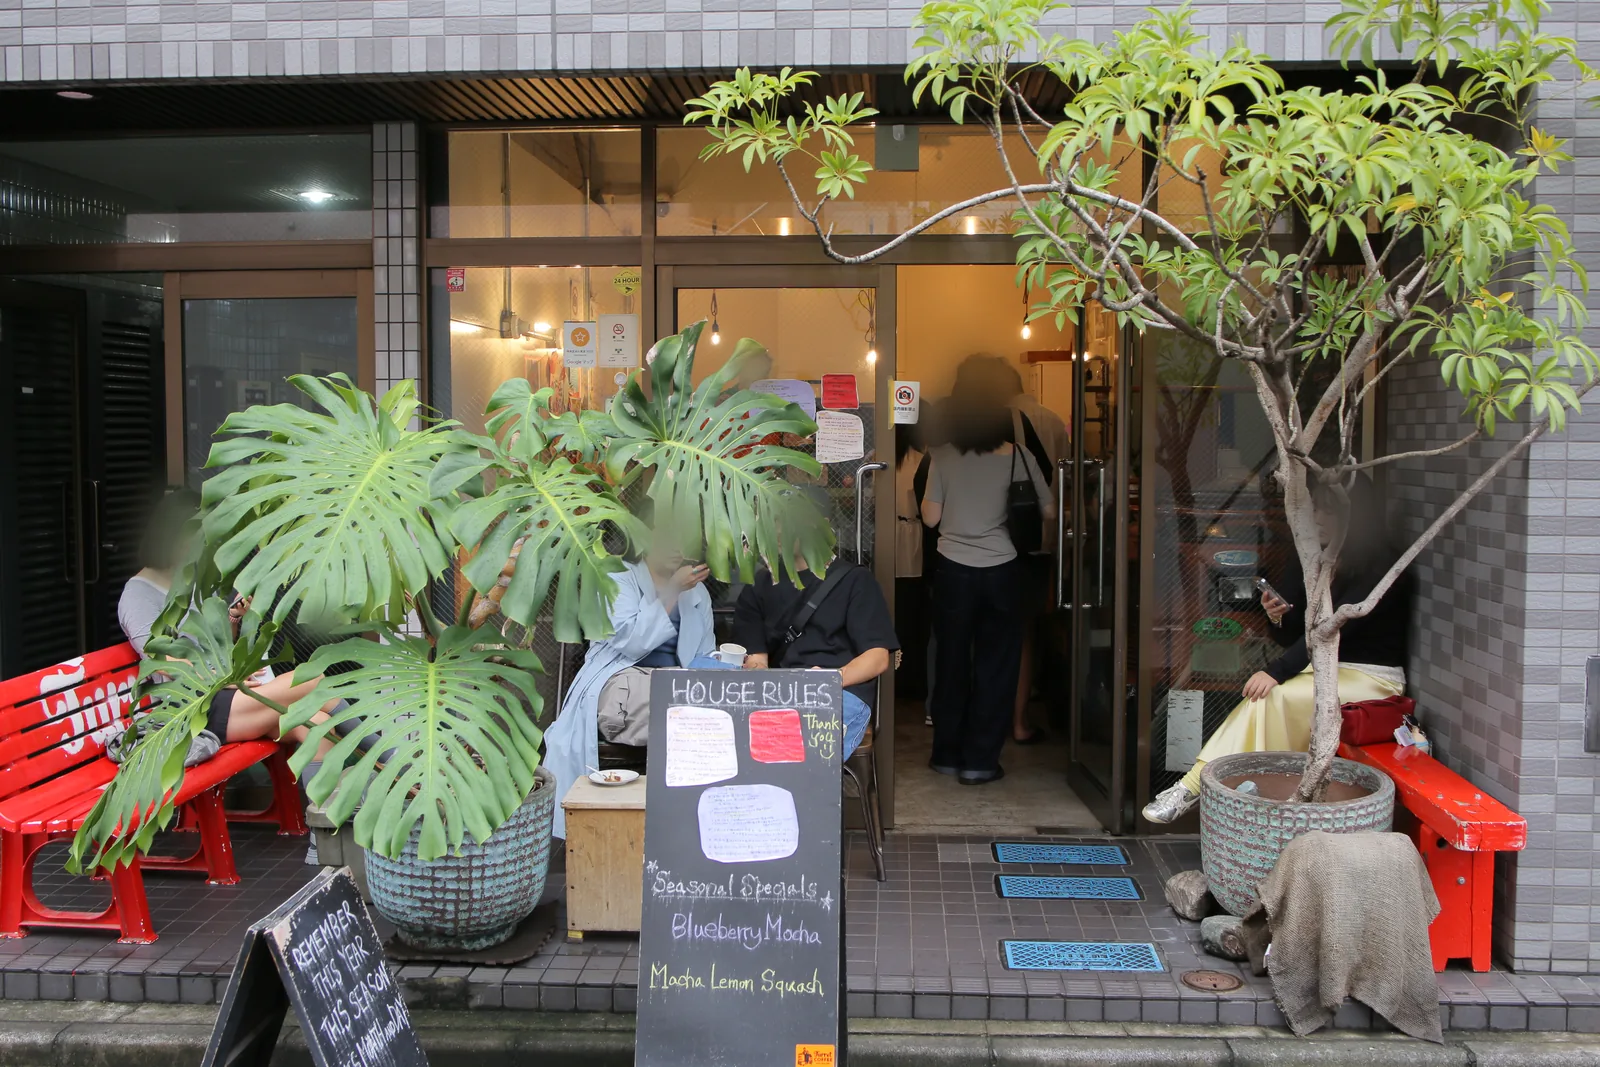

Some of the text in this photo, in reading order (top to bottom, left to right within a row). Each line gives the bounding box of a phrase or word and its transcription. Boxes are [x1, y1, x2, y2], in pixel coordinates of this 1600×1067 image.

[672, 678, 833, 707] HOUSE RULES
[802, 712, 840, 731] Thank
[809, 732, 836, 748] you
[652, 870, 818, 902] Seasonal Specials
[291, 900, 358, 970] REMEMBER
[671, 912, 822, 950] Blueberry Mocha
[312, 935, 370, 999] THIS YEAR
[649, 963, 824, 998] Macha Lemon Squash
[320, 960, 392, 1047] THIS SEASON
[387, 995, 411, 1034] DAY
